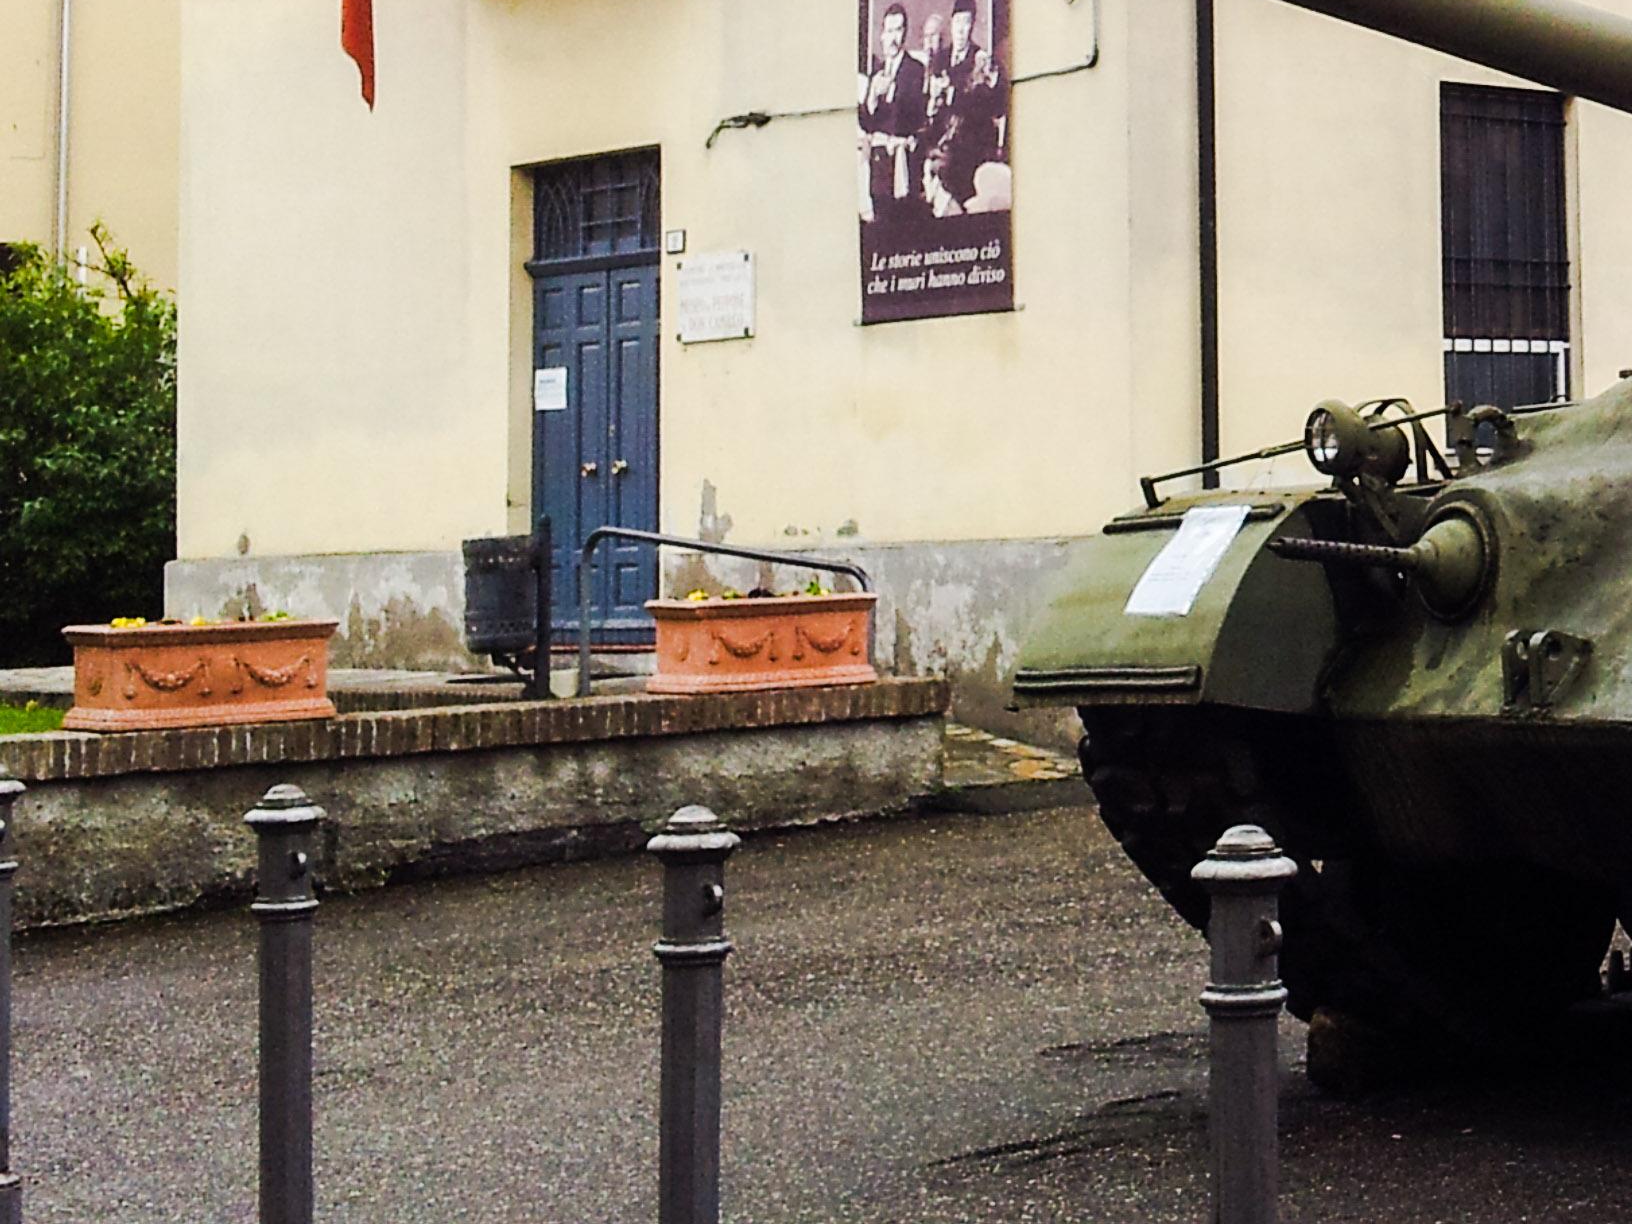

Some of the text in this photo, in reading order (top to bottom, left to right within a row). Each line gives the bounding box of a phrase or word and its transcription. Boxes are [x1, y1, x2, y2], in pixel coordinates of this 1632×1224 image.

[870, 239, 1001, 271] Le storie uniscono ciò
[867, 265, 1006, 295] che i muri hanno diviso
